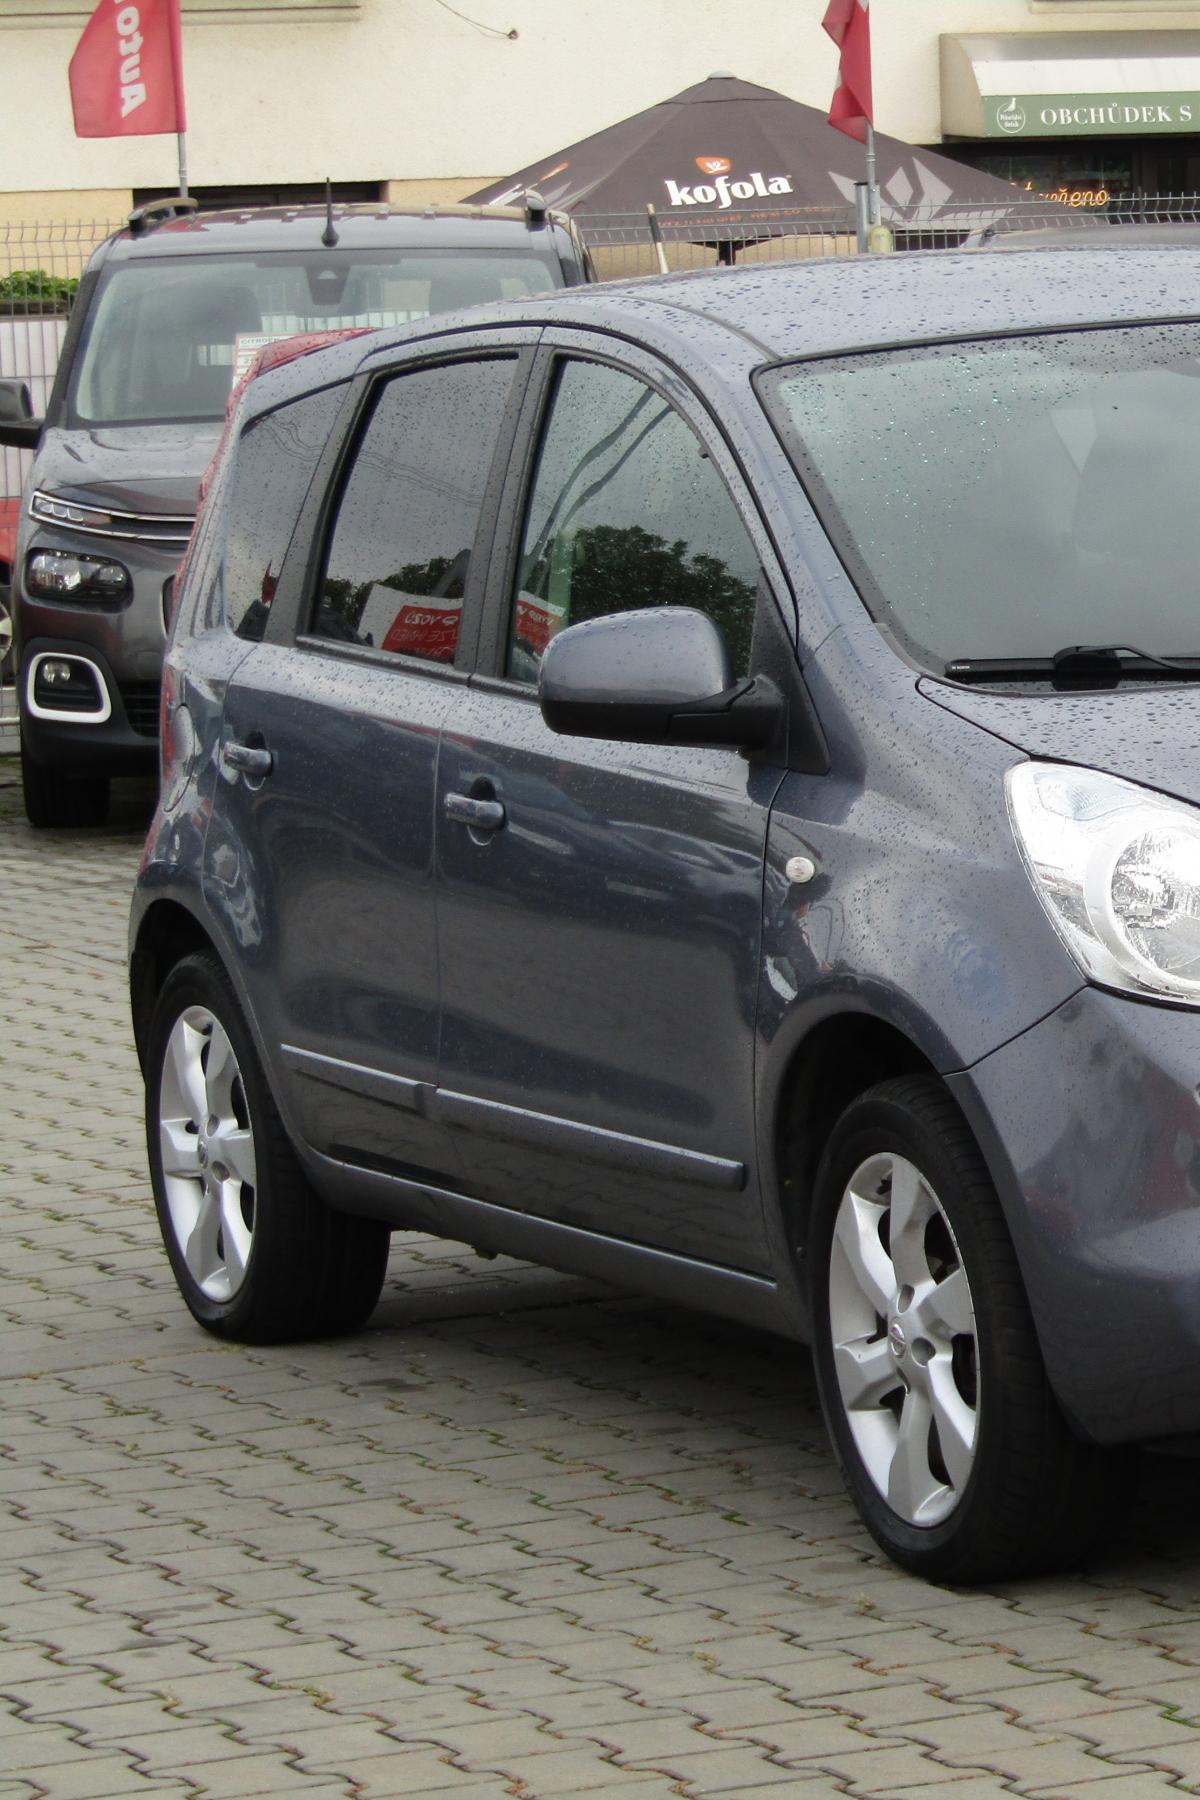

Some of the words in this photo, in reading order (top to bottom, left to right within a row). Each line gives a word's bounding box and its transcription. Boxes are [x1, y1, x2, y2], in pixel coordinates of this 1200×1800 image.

[1040, 102, 1173, 126] OBCHŮDEK
[1179, 105, 1193, 122] S
[664, 172, 794, 209] kofola
